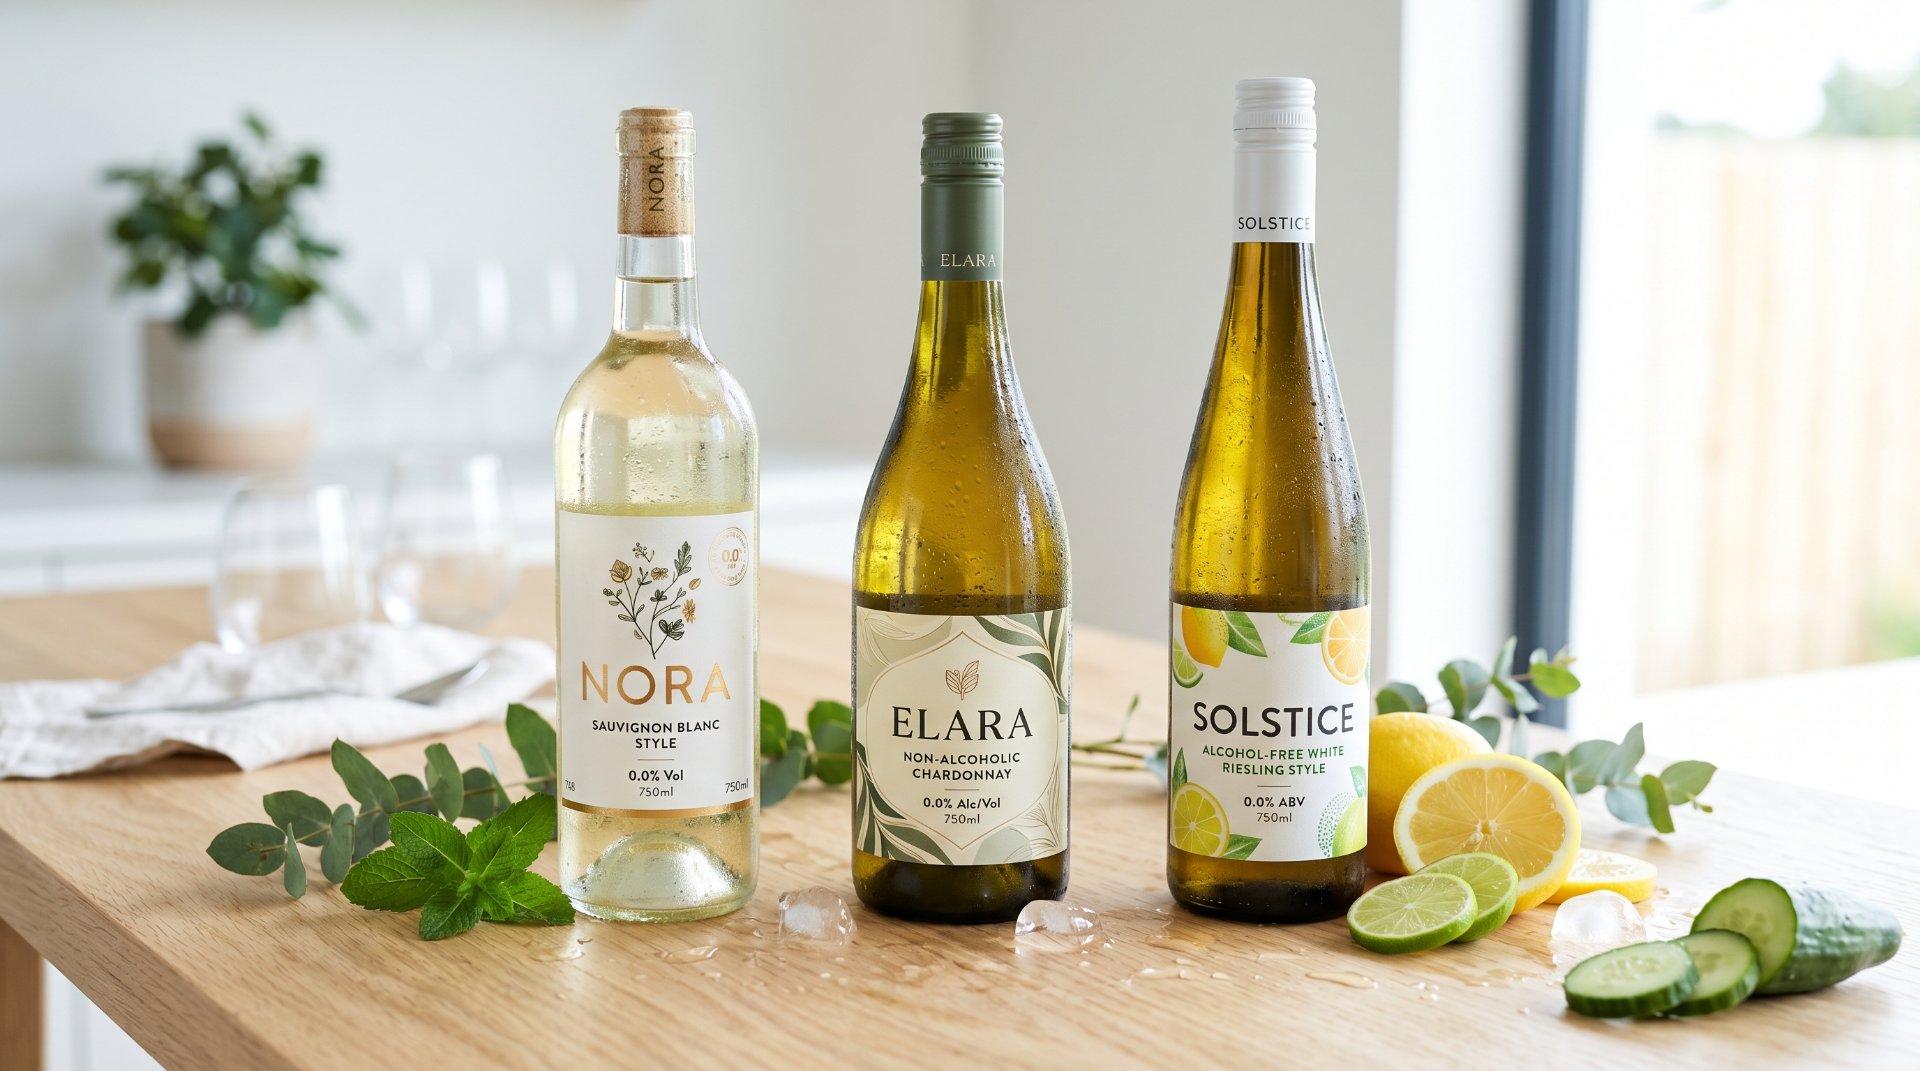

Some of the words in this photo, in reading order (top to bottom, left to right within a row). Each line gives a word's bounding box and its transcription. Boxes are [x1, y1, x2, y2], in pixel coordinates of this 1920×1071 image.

[649, 147, 664, 211] NORA
[1238, 217, 1310, 230] SOLSTICE
[941, 254, 996, 267] ELARA
[582, 661, 731, 705] NORA
[892, 706, 1033, 741] ELARA
[1193, 702, 1354, 737] SOLSTICE
[592, 720, 672, 733] SAUVIGNON
[678, 720, 720, 732] BLANC
[636, 738, 676, 749] STYLE
[904, 752, 1020, 765] NON-ALCOHOLIC
[1203, 745, 1303, 759] ALCOHOL-FREE
[1308, 746, 1344, 759] WHITE
[629, 770, 660, 781] 0.0%
[664, 770, 684, 781] Vol
[913, 769, 1012, 780] CHARDONNAY
[1223, 763, 1284, 775] RIESLING
[1289, 763, 1326, 775] STYLE
[639, 787, 674, 797] 750ml
[725, 779, 748, 793] 750ml
[923, 798, 952, 808] 0.0%
[957, 798, 1001, 809] Alc/Vol
[1244, 797, 1274, 807] 0.0%
[1279, 797, 1305, 807] ABV
[945, 814, 980, 824] 750ml
[1257, 813, 1292, 823] 750ml
